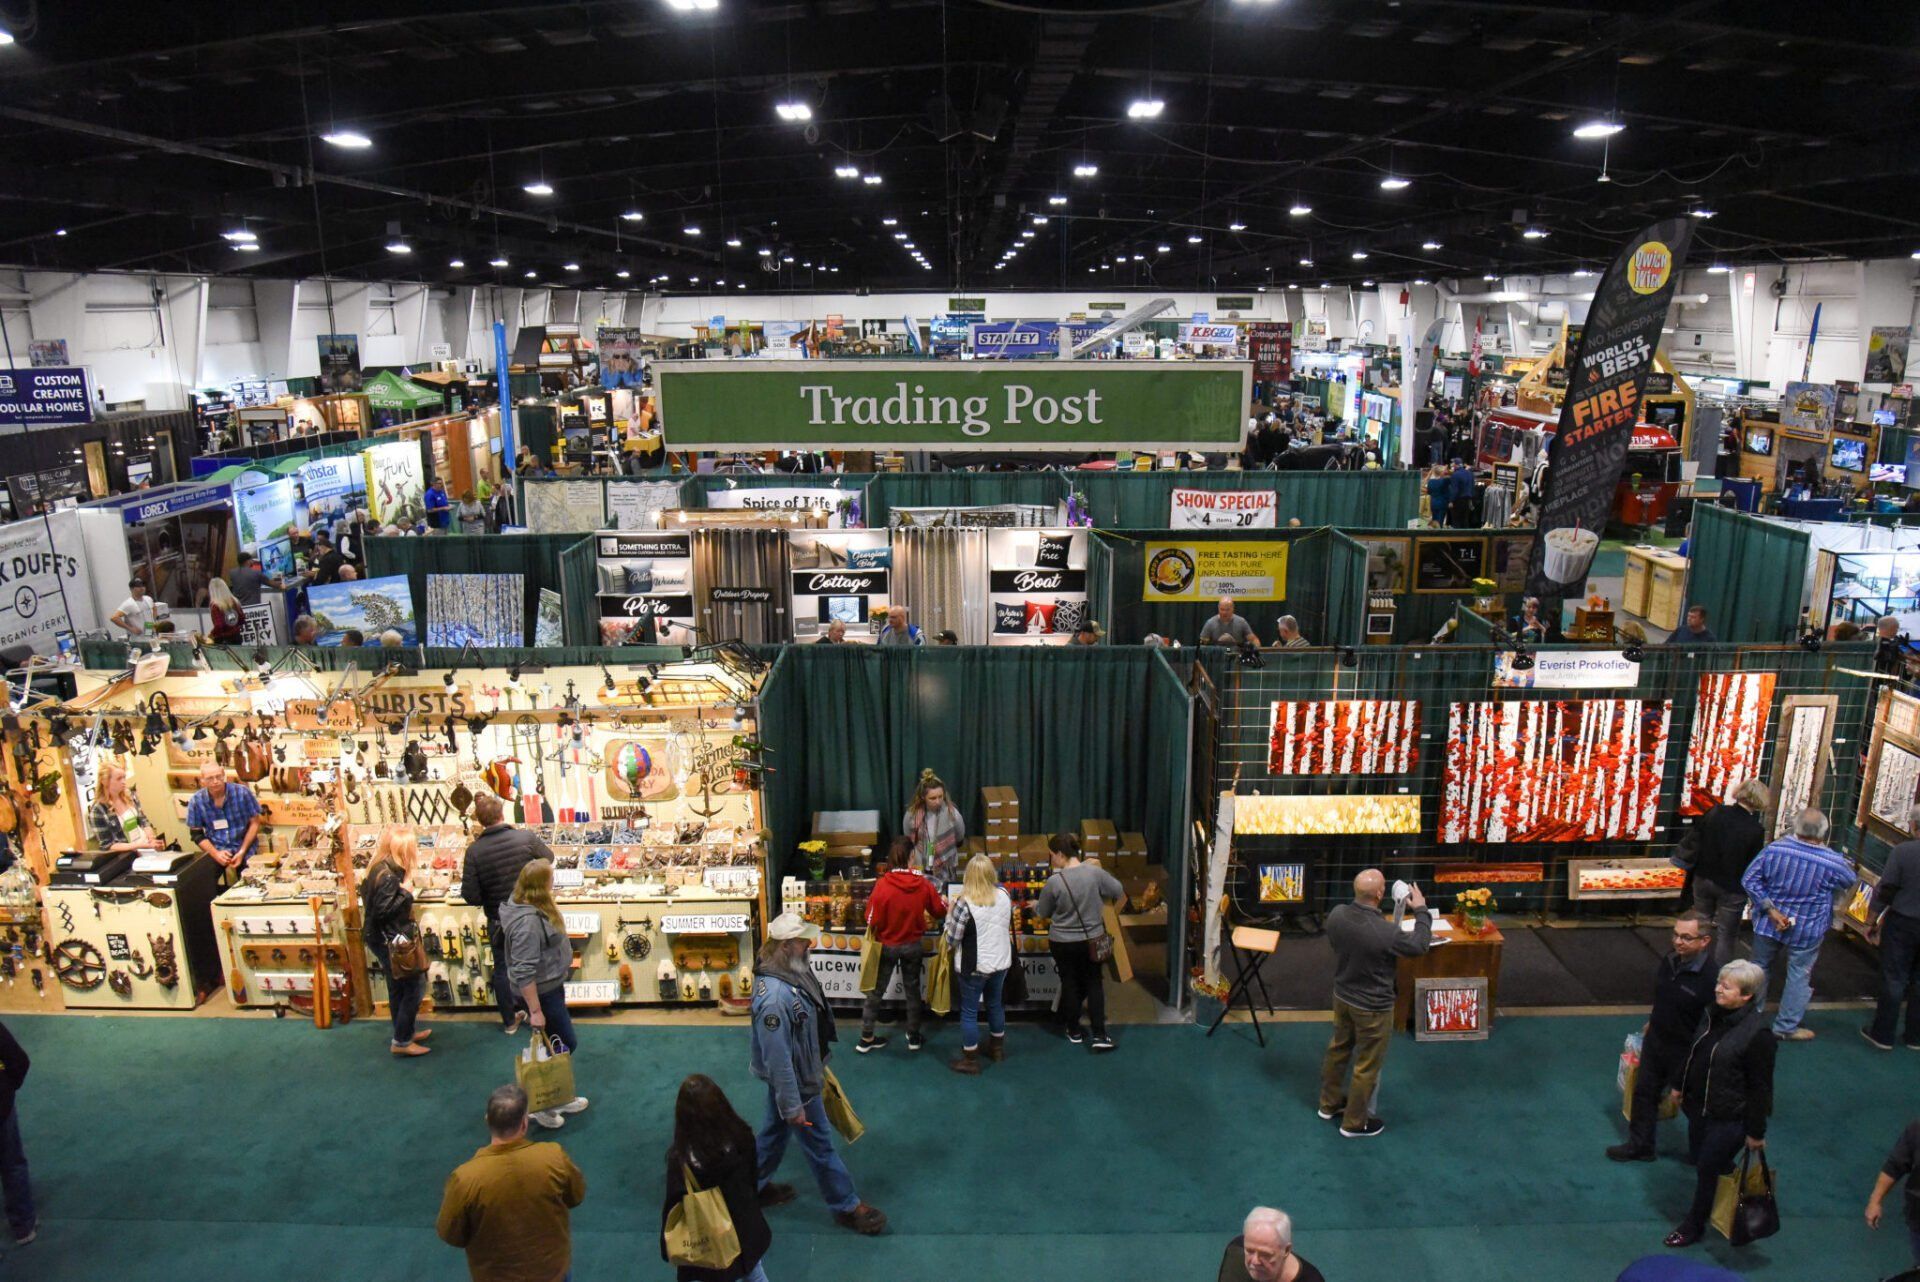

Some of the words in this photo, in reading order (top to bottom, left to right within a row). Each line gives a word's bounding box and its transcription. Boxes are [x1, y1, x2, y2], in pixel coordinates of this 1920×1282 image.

[980, 333, 1037, 344] STANLEY
[1191, 326, 1235, 339] KEGEL
[1250, 330, 1277, 340] Cottage
[1278, 330, 1292, 338] Life
[1583, 335, 1644, 368] WORLD'S
[1601, 344, 1651, 379] BEST
[34, 376, 81, 385] CUSTOM
[33, 389, 83, 399] CREATIVE
[0, 403, 43, 413] ODULAR
[46, 402, 85, 412] HOMES
[800, 382, 991, 437] Trading
[1003, 384, 1104, 424] Post
[1573, 380, 1638, 427] FIRE
[1564, 407, 1635, 446] STARTER
[743, 496, 781, 509] Spice
[784, 495, 798, 509] of
[1176, 493, 1216, 509] SHOW
[1219, 494, 1271, 510] SPECIAL
[140, 501, 169, 518] LOREX
[1202, 512, 1211, 526] 4
[618, 543, 659, 551] SOMETHING
[1039, 538, 1064, 550] Born
[852, 550, 888, 562] Georgian
[1040, 550, 1060, 560] Free
[1260, 551, 1283, 559] HERE
[13, 552, 77, 579] DUFF'S
[808, 573, 872, 593] Cottage
[1013, 570, 1064, 592] Boat
[739, 589, 770, 602] Drapery
[245, 610, 268, 619] GANIC
[1002, 616, 1020, 628] Edge
[0, 624, 38, 647] RGANIC
[40, 614, 68, 633] JERKY
[1539, 660, 1576, 670] Everist
[1578, 659, 1631, 670] Prokofiev
[366, 692, 466, 714] URISTS
[294, 704, 339, 716] Sha's
[319, 717, 354, 728] reek
[665, 918, 705, 930] SUMMER
[711, 917, 743, 929] HOUSE
[596, 985, 611, 998] ST.
